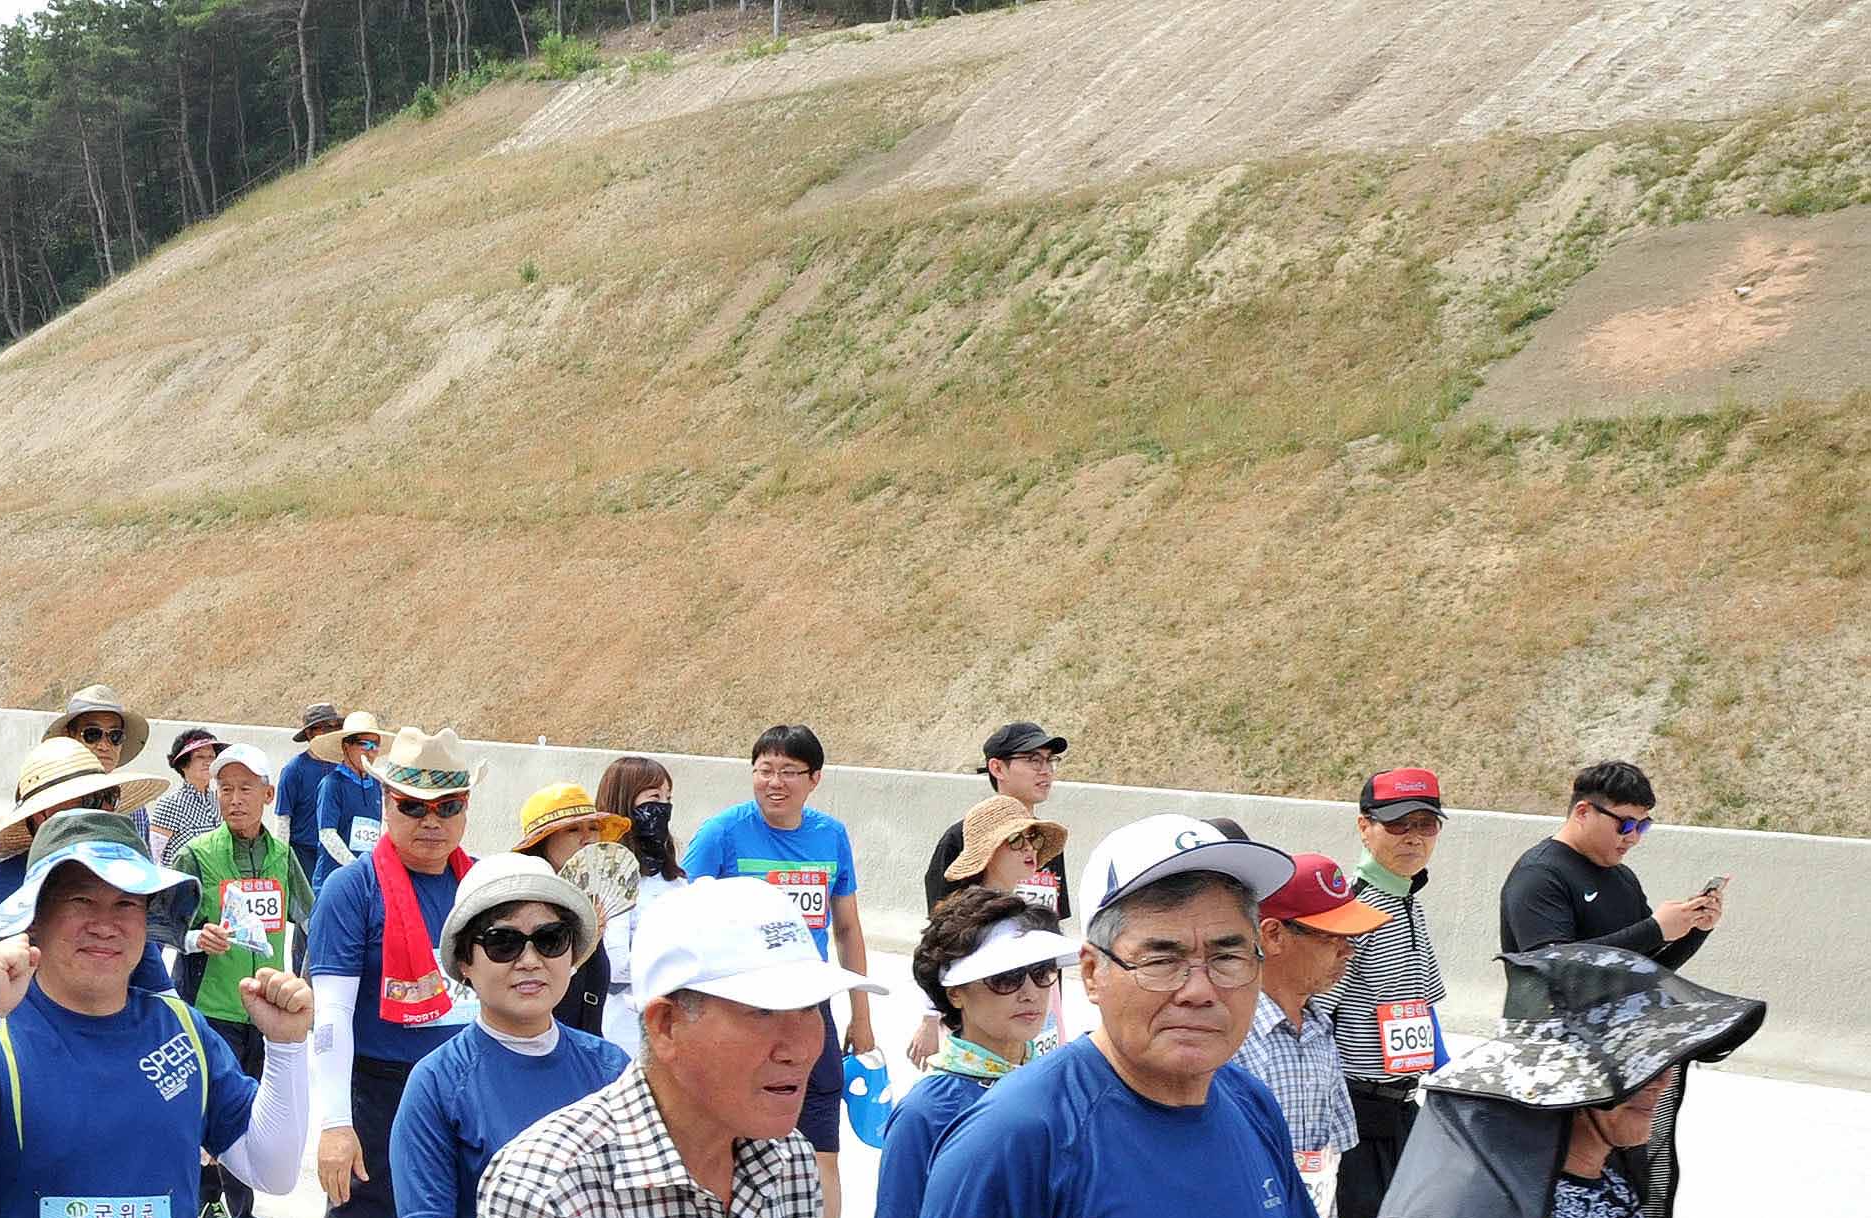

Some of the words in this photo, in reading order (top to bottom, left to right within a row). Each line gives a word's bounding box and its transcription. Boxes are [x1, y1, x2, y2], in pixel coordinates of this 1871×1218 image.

[245, 896, 279, 917] 158
[787, 891, 823, 912] 709
[402, 1009, 441, 1023] SPORTS
